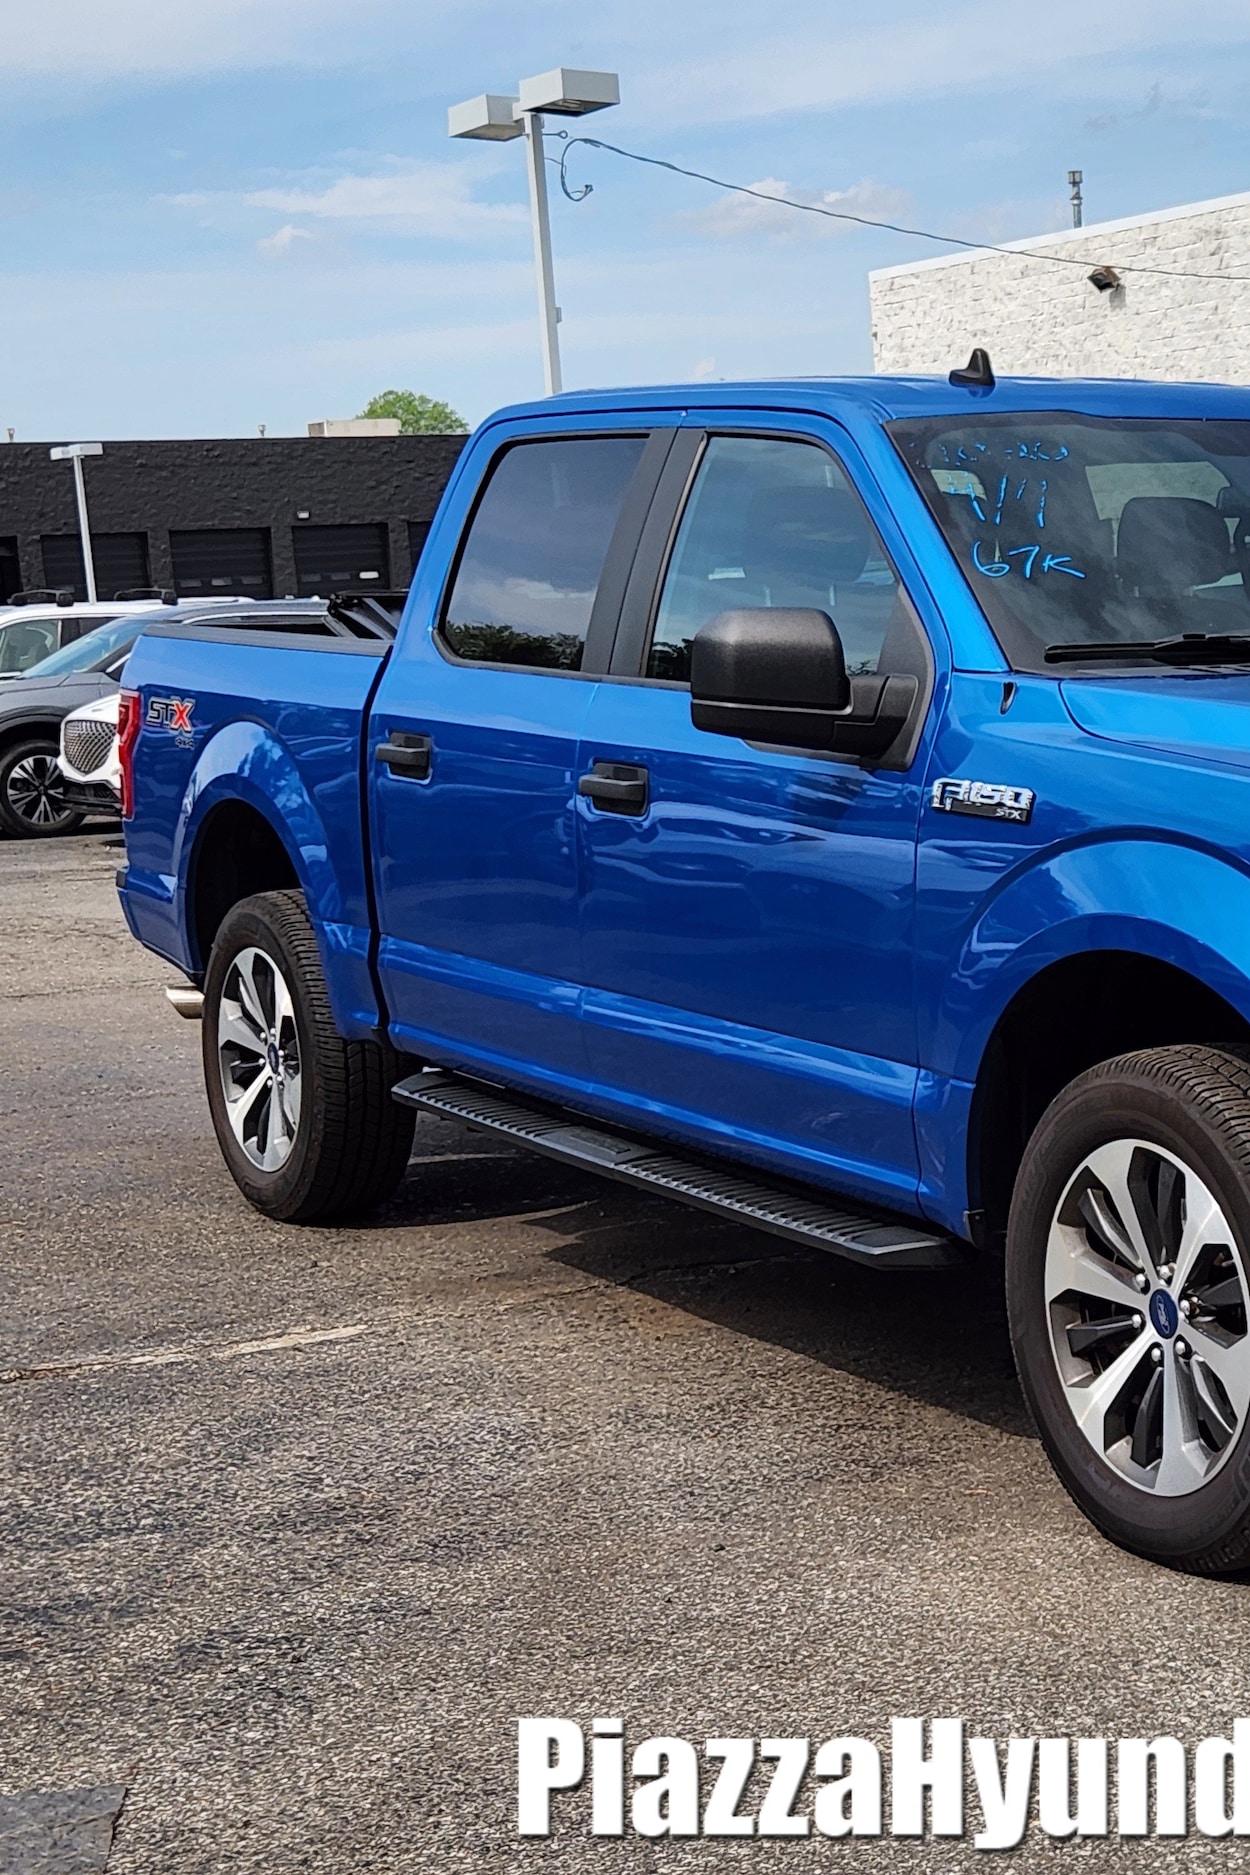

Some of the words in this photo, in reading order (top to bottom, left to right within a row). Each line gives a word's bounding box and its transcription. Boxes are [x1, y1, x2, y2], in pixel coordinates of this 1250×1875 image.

[973, 541, 1086, 578] 67K
[146, 696, 196, 736] STX
[995, 807, 1022, 819] STX
